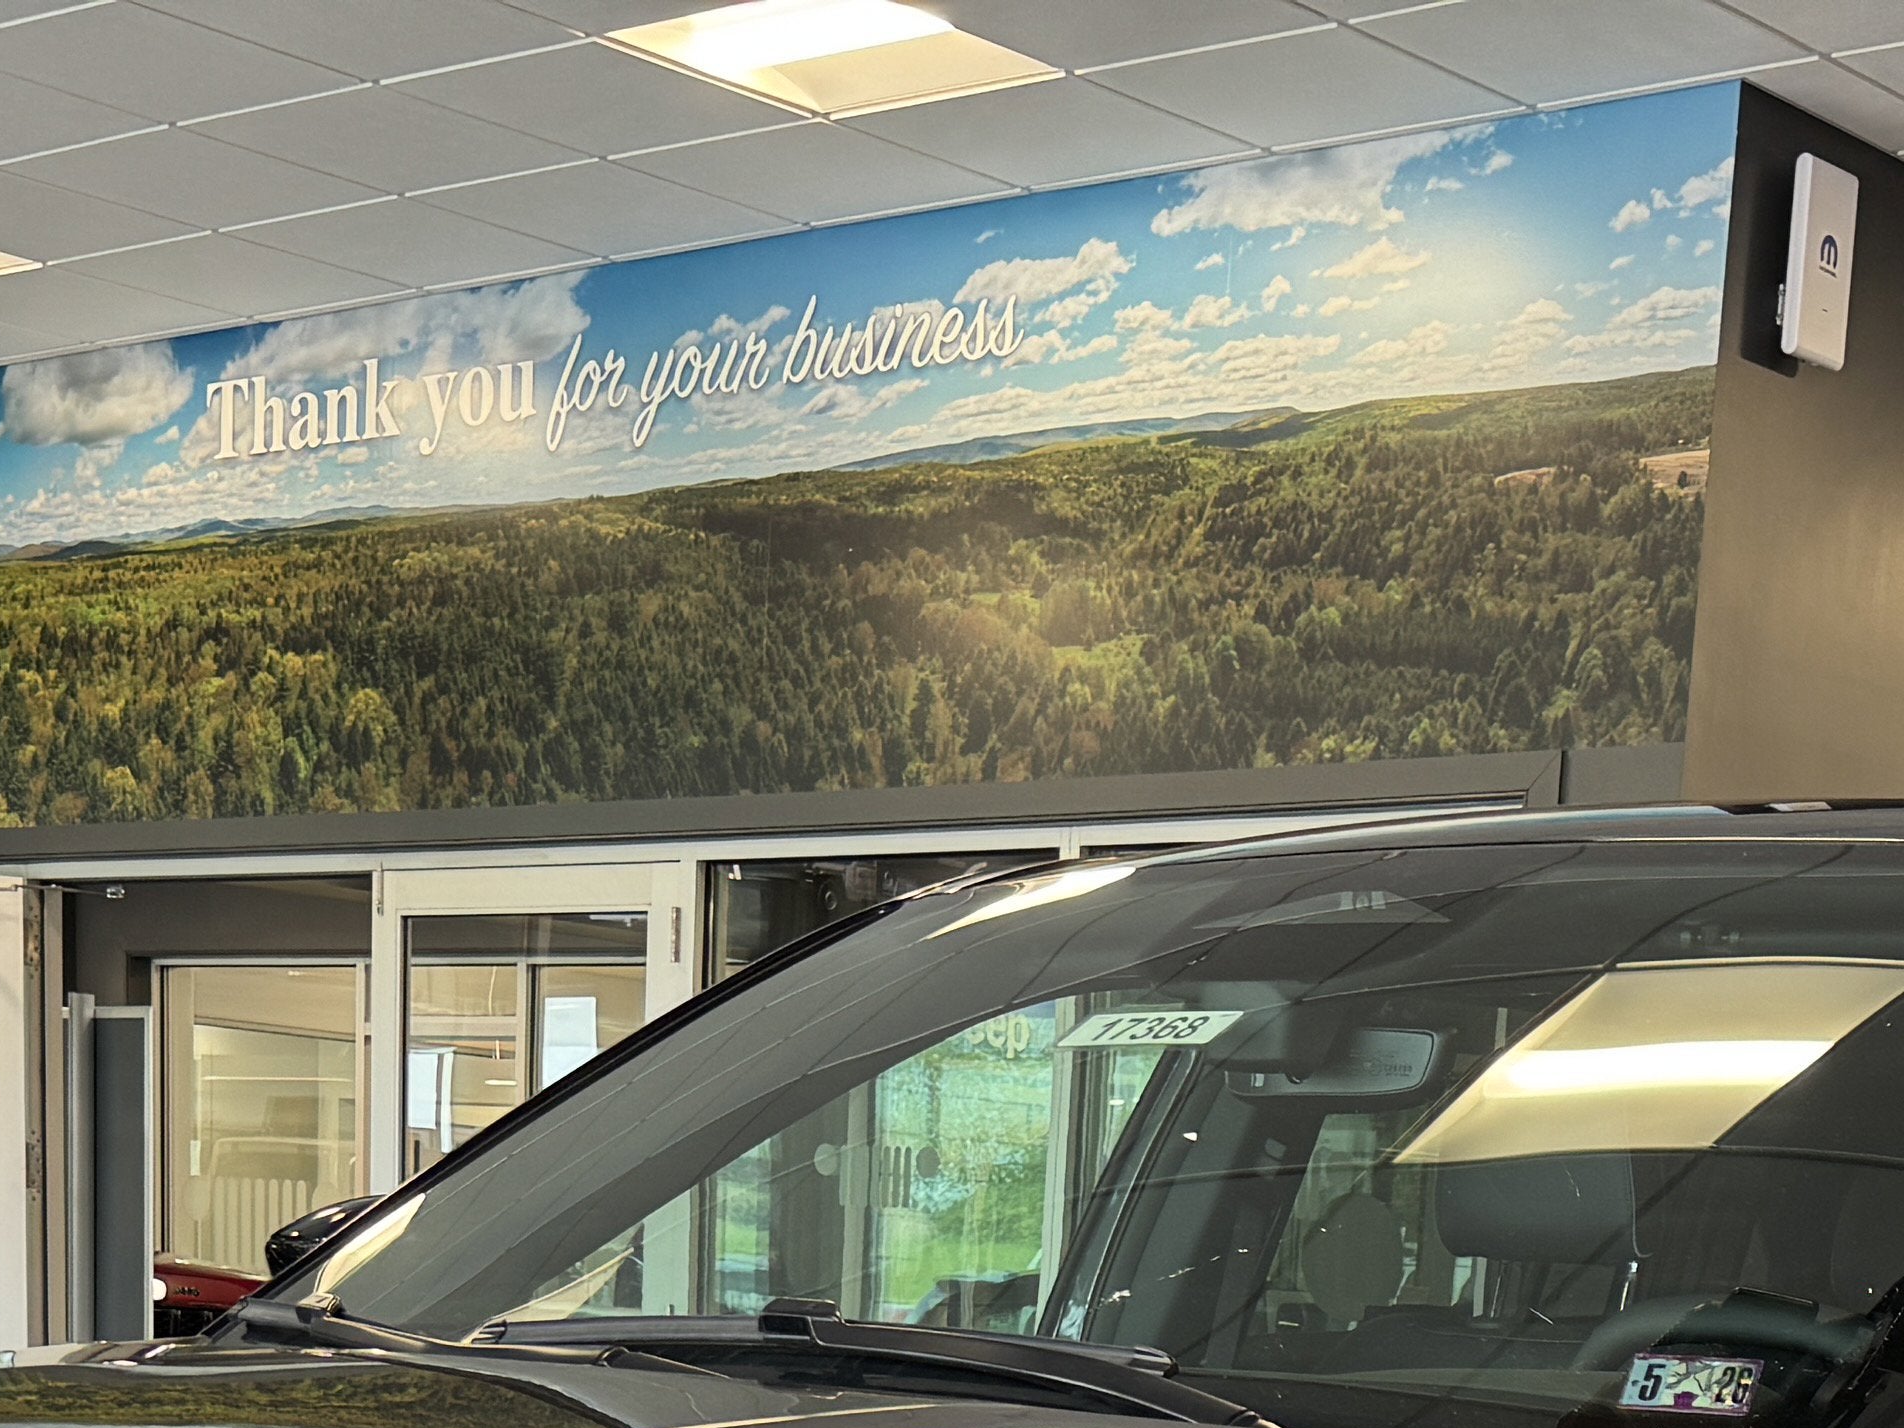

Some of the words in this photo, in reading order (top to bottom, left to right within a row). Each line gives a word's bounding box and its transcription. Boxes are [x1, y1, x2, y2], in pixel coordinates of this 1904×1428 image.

[206, 358, 401, 460] Thank
[419, 360, 537, 456] you
[546, 333, 628, 452] for
[633, 330, 770, 448] your
[782, 295, 1025, 384] business
[964, 1013, 1031, 1059] eep
[1092, 1016, 1210, 1042] 17368
[1638, 1363, 1666, 1402] 5
